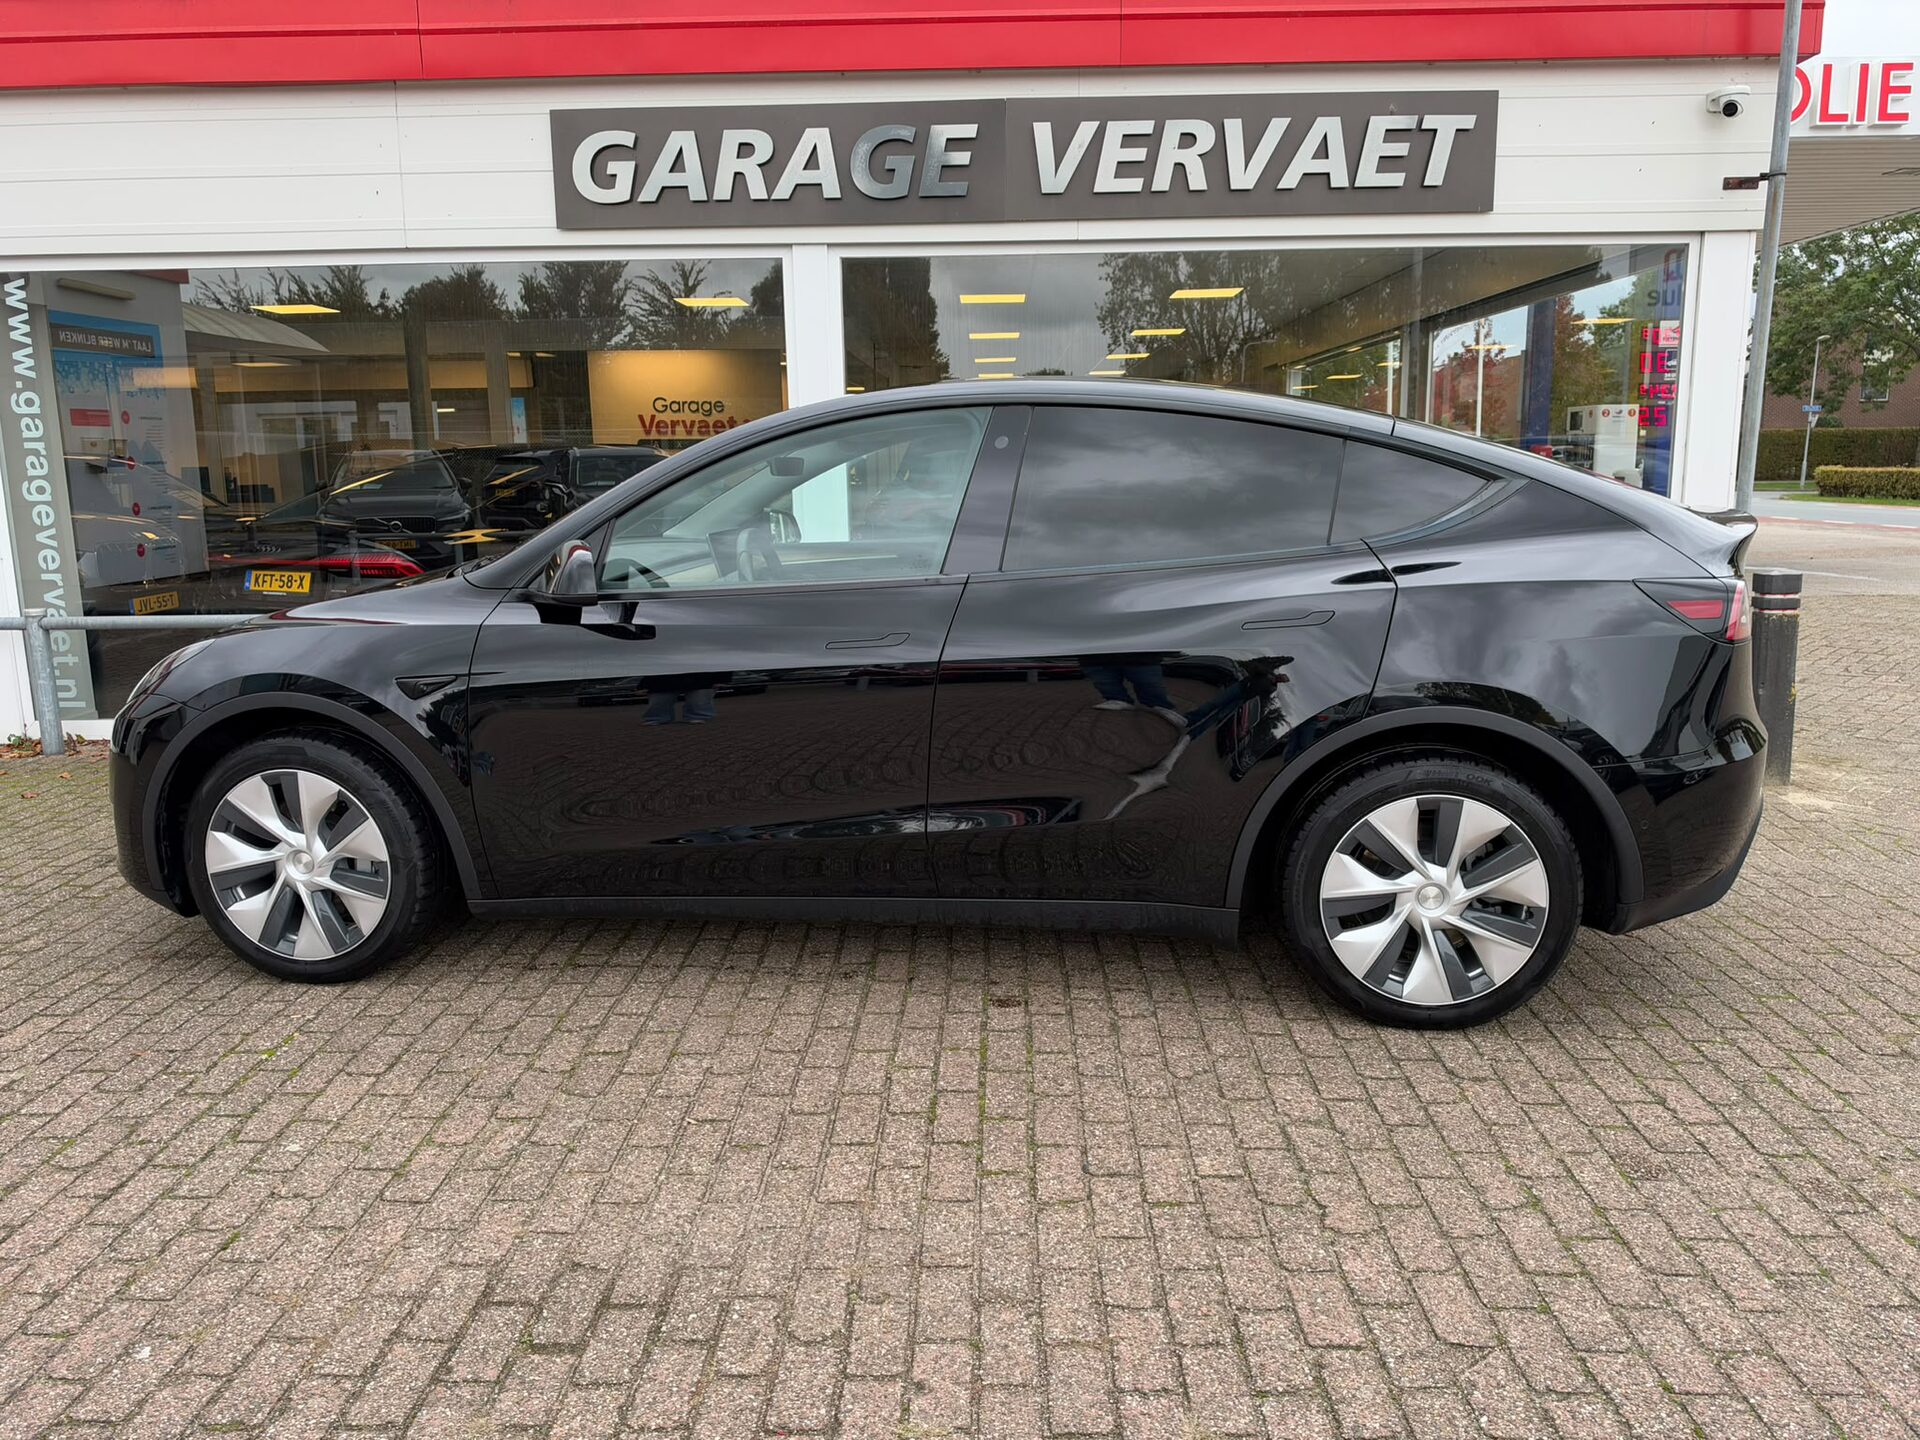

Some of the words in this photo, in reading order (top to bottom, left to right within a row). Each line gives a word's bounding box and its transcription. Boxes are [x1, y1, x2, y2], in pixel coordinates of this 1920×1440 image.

[571, 123, 979, 205] GARAGE
[1032, 113, 1477, 195] VERVAET
[652, 397, 725, 417] Garage
[637, 414, 738, 437] Vervaet
[254, 573, 306, 590] KFT-58-X
[138, 594, 175, 613] JVL-55-T
